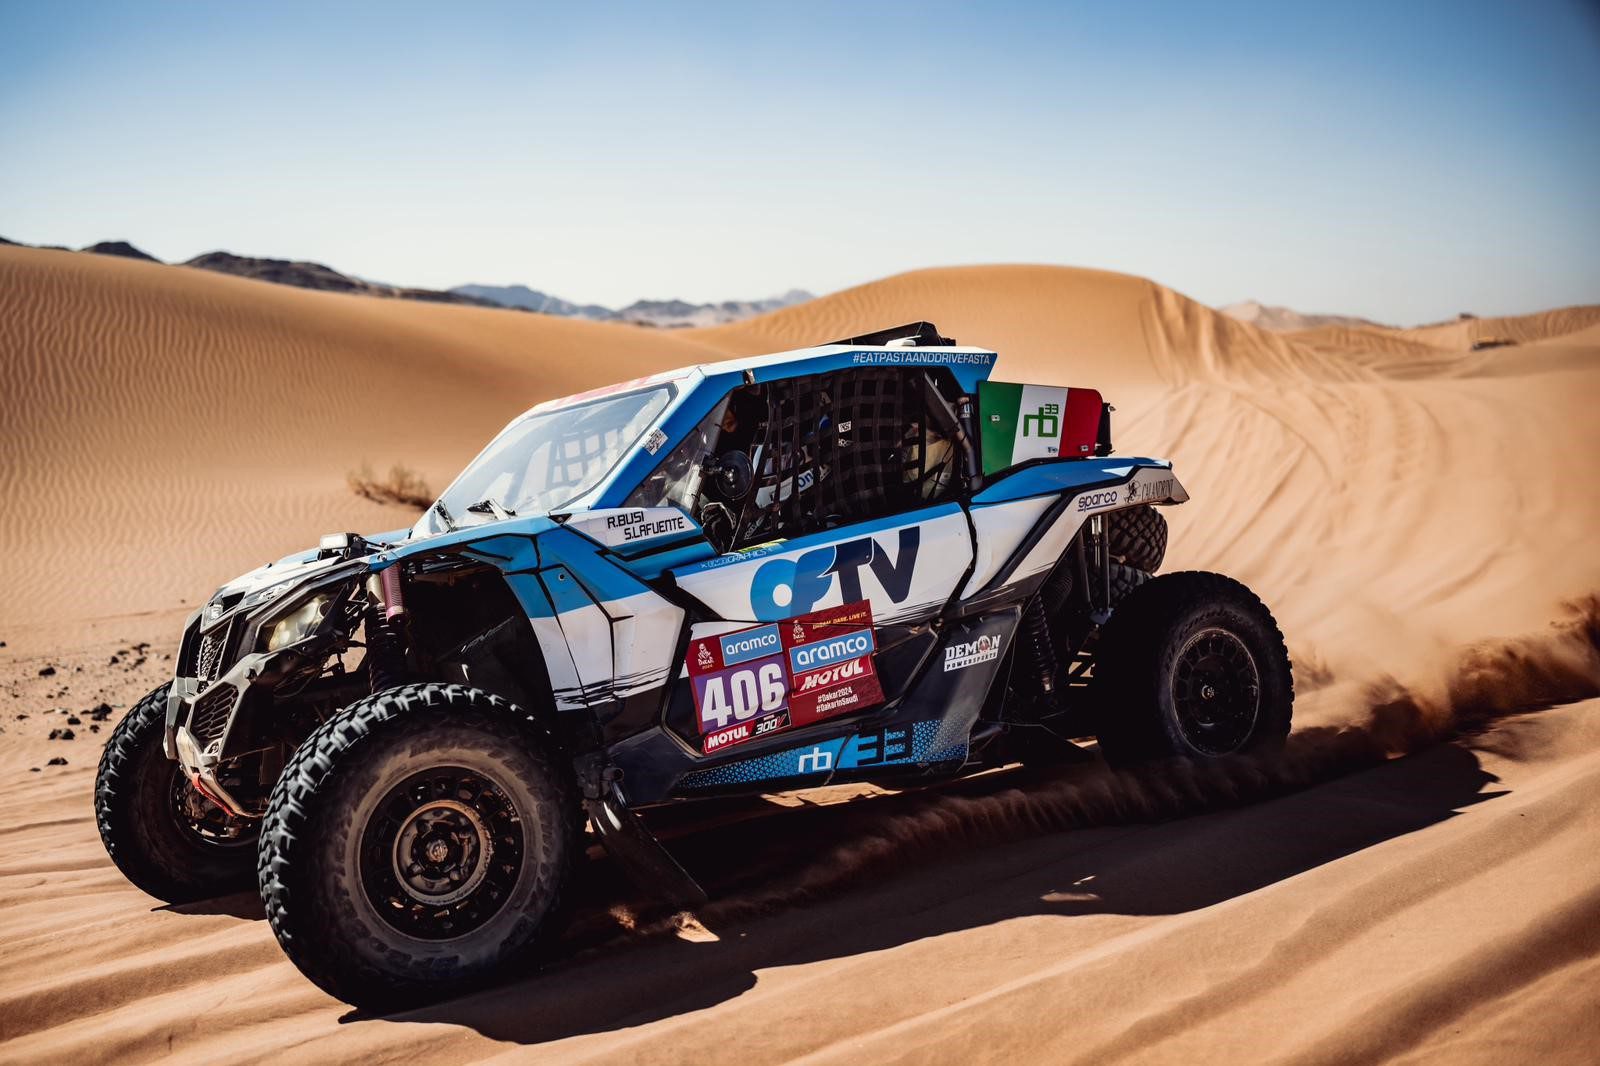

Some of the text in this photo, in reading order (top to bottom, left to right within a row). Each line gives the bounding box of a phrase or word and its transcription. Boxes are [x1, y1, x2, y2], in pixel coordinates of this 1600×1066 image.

[853, 352, 991, 365] #EATPASTAANDDRIVEFASTA
[1078, 490, 1118, 512] sparco
[607, 510, 645, 529] R.BUSI
[624, 516, 684, 540] S.LAFUENTE
[726, 634, 777, 656] aramco
[797, 636, 868, 666] aramco
[945, 635, 1001, 661] DEMON
[800, 658, 864, 692] MOTUL
[701, 663, 786, 728] 406
[817, 686, 853, 704] #Dakar2024
[707, 725, 749, 750] MOTUL
[798, 747, 832, 773] rb
